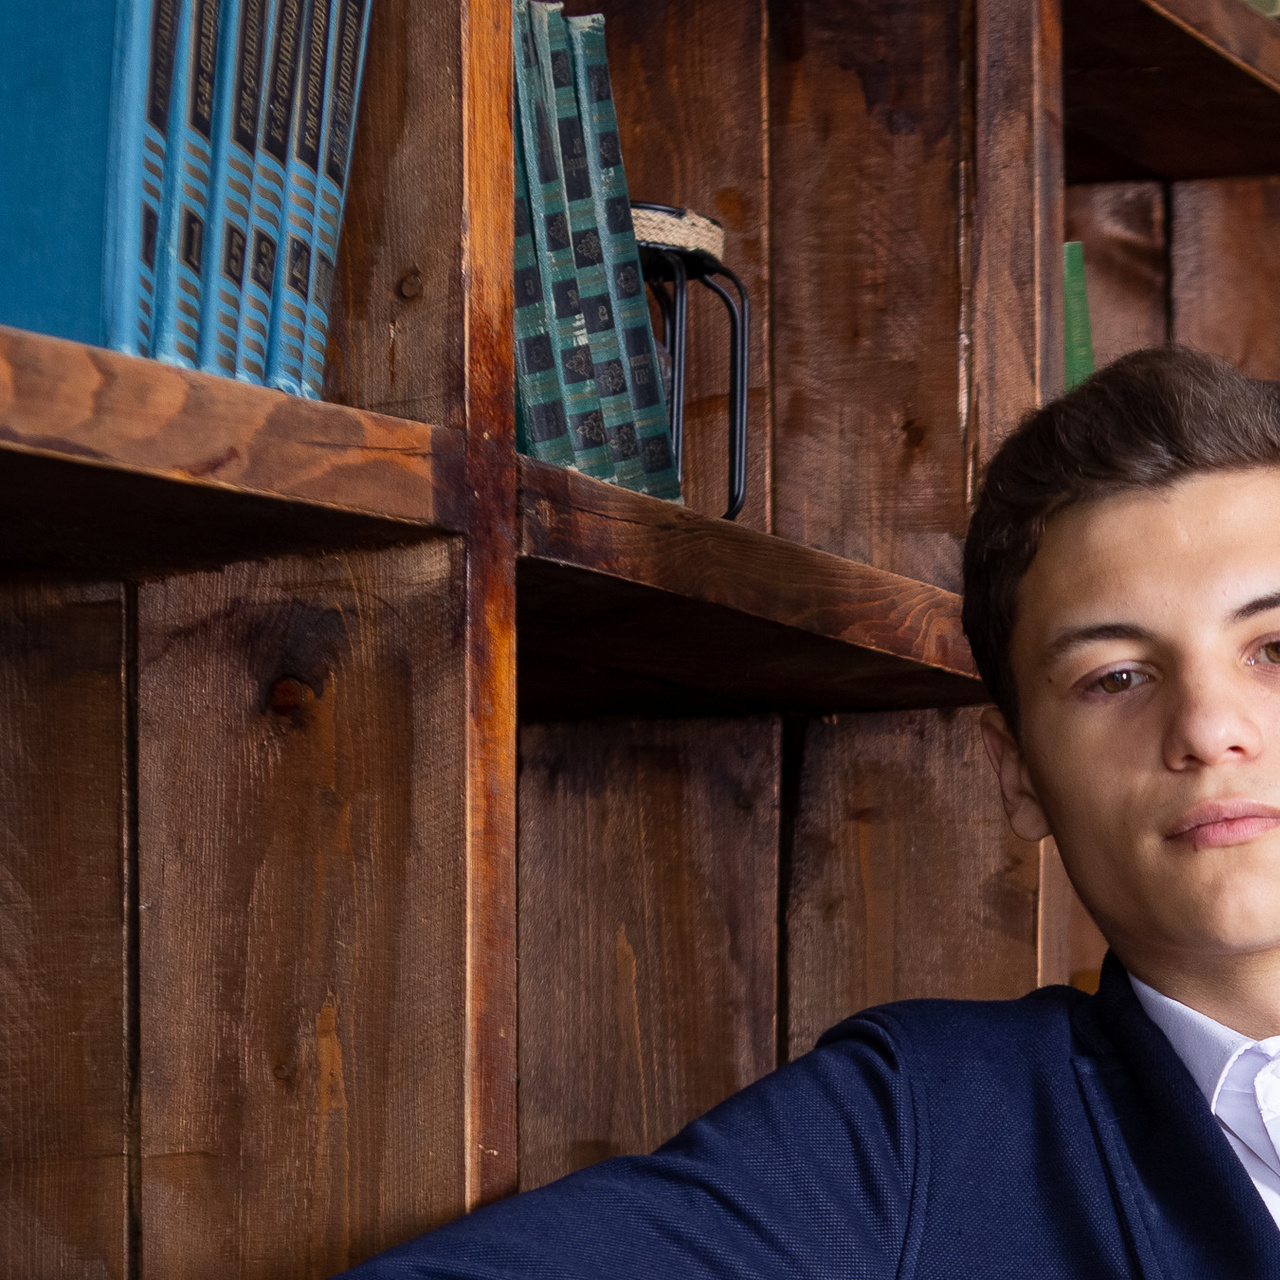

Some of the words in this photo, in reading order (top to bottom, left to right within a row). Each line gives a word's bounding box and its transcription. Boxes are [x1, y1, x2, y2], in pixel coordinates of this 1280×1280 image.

[191, 222, 200, 267] 1
[230, 231, 243, 277] 5
[258, 241, 272, 282] 3
